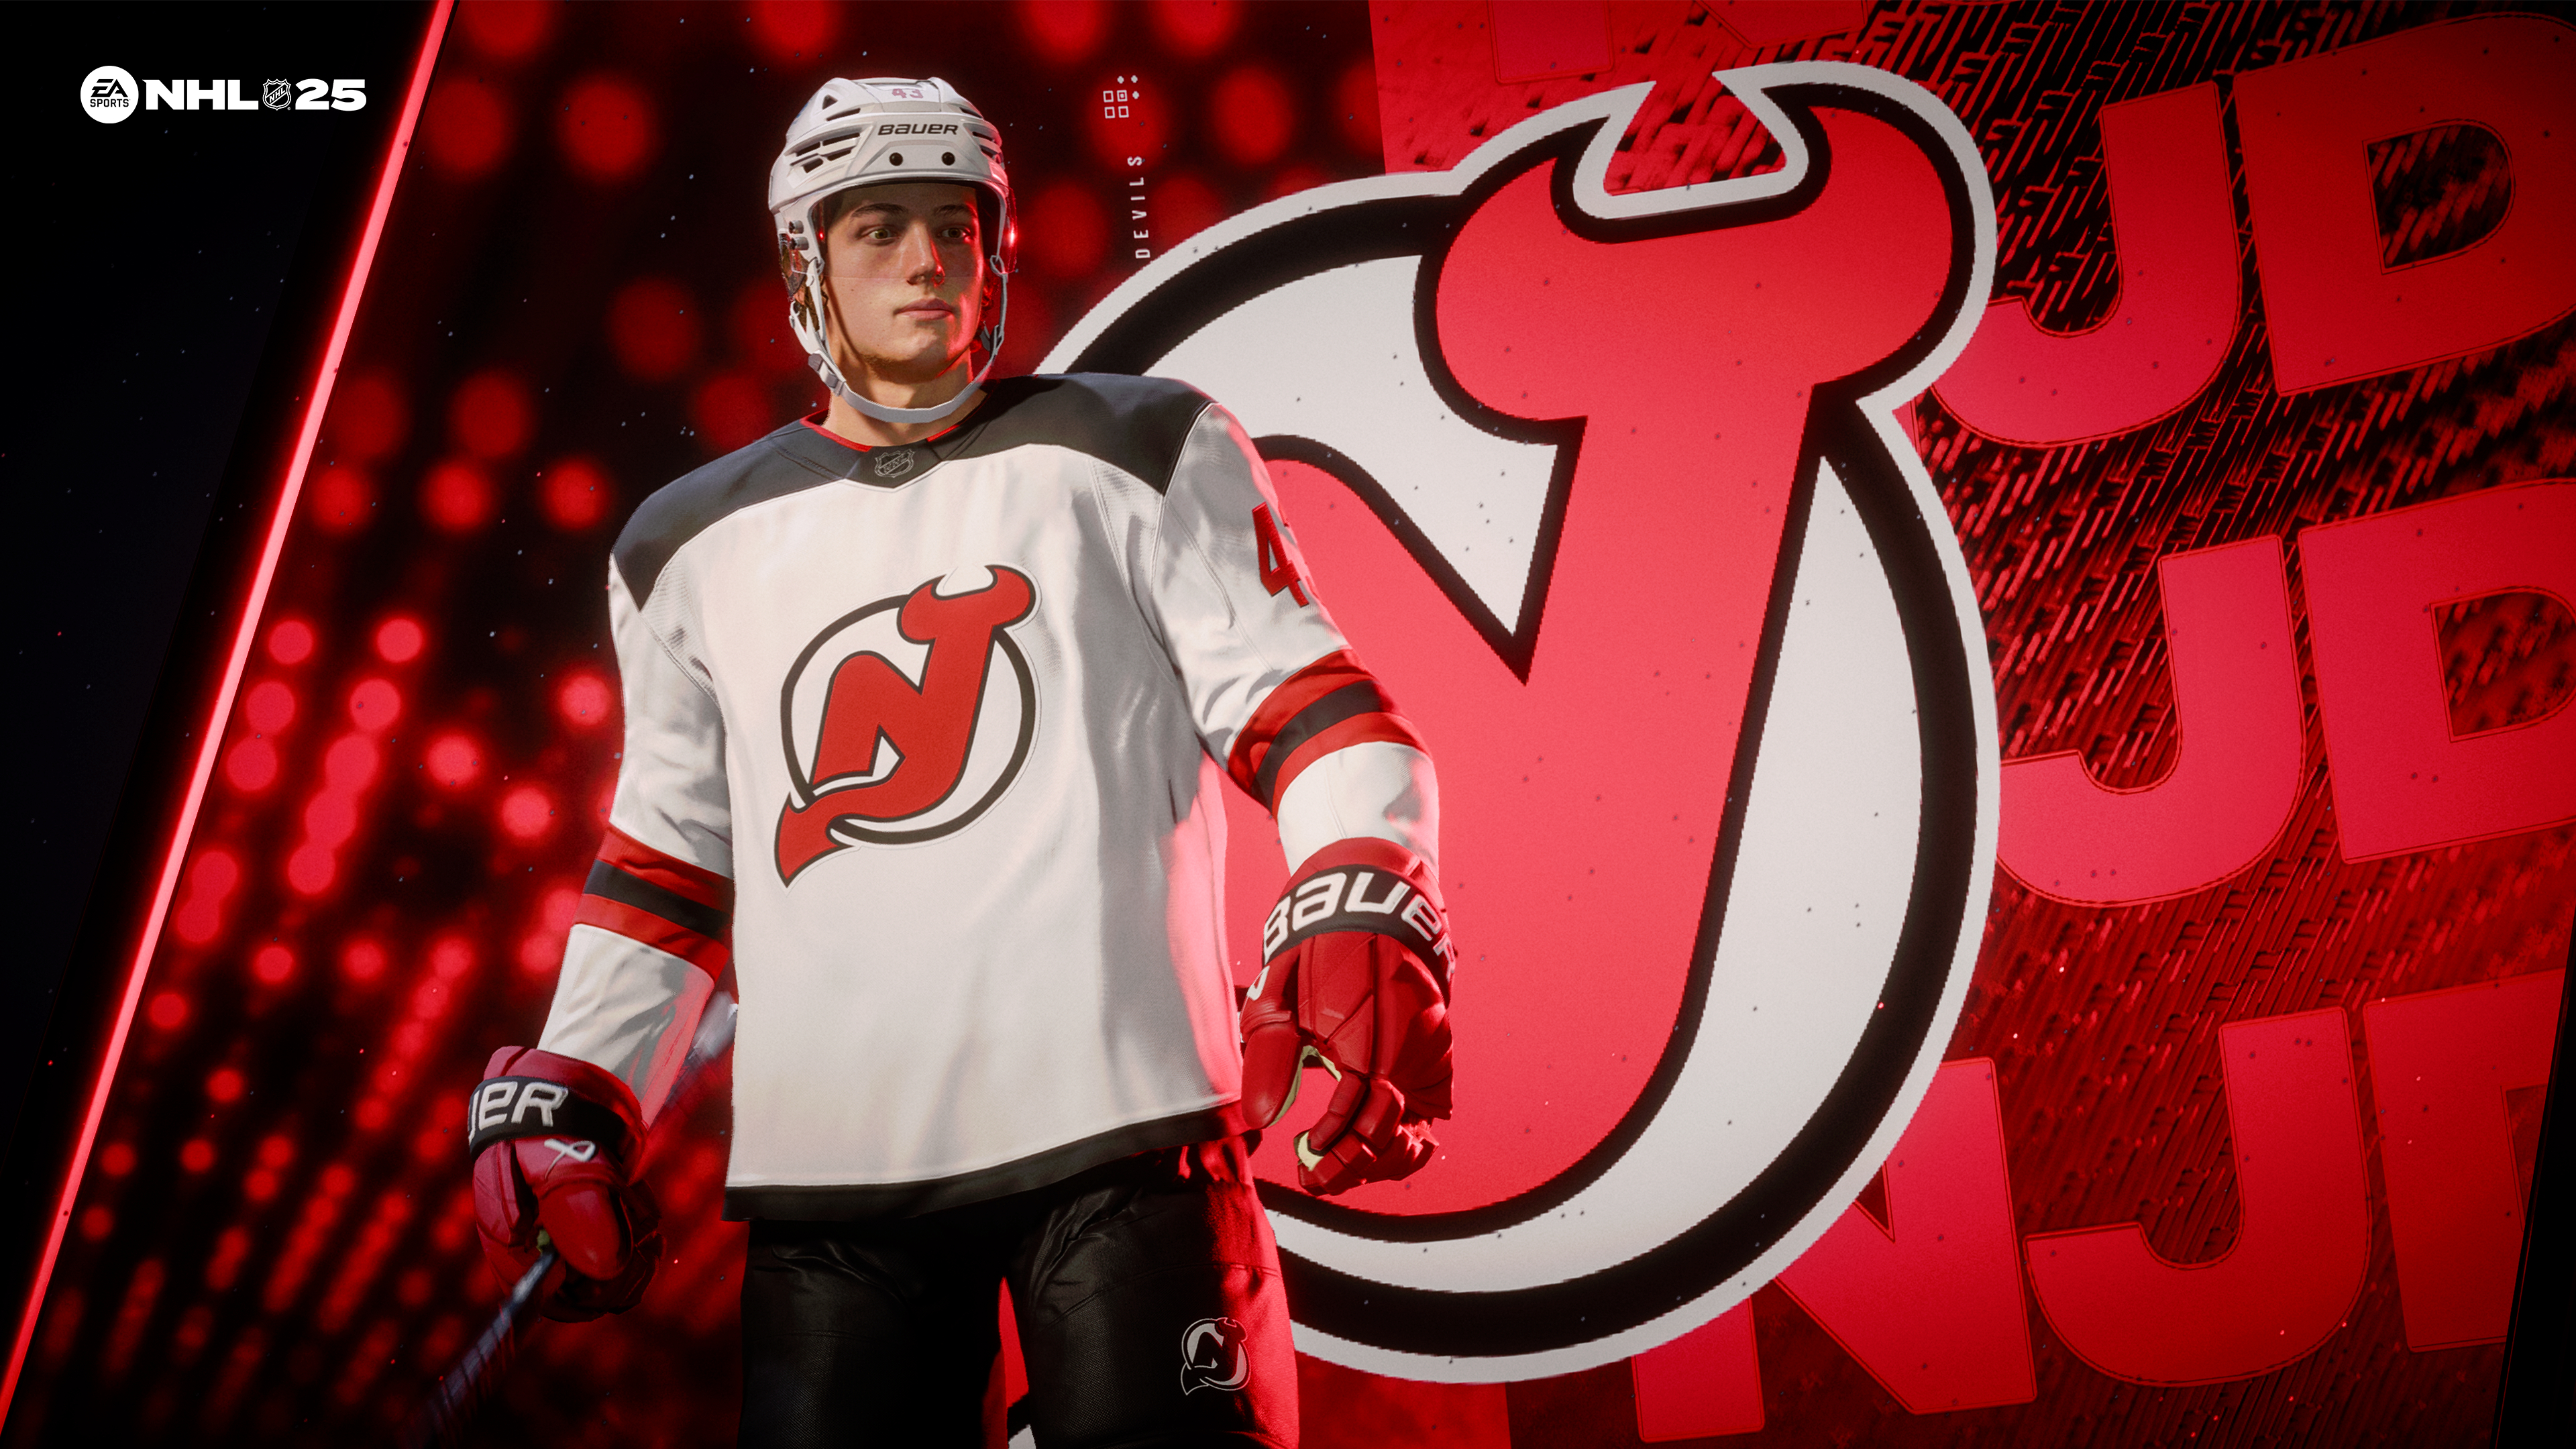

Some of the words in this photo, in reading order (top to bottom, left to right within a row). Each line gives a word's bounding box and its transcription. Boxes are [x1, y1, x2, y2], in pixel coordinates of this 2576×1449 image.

[892, 88, 924, 99] 43
[1127, 156, 1150, 258] DEVILS
[1923, 10, 2576, 449] JD
[1252, 501, 1325, 608] 4
